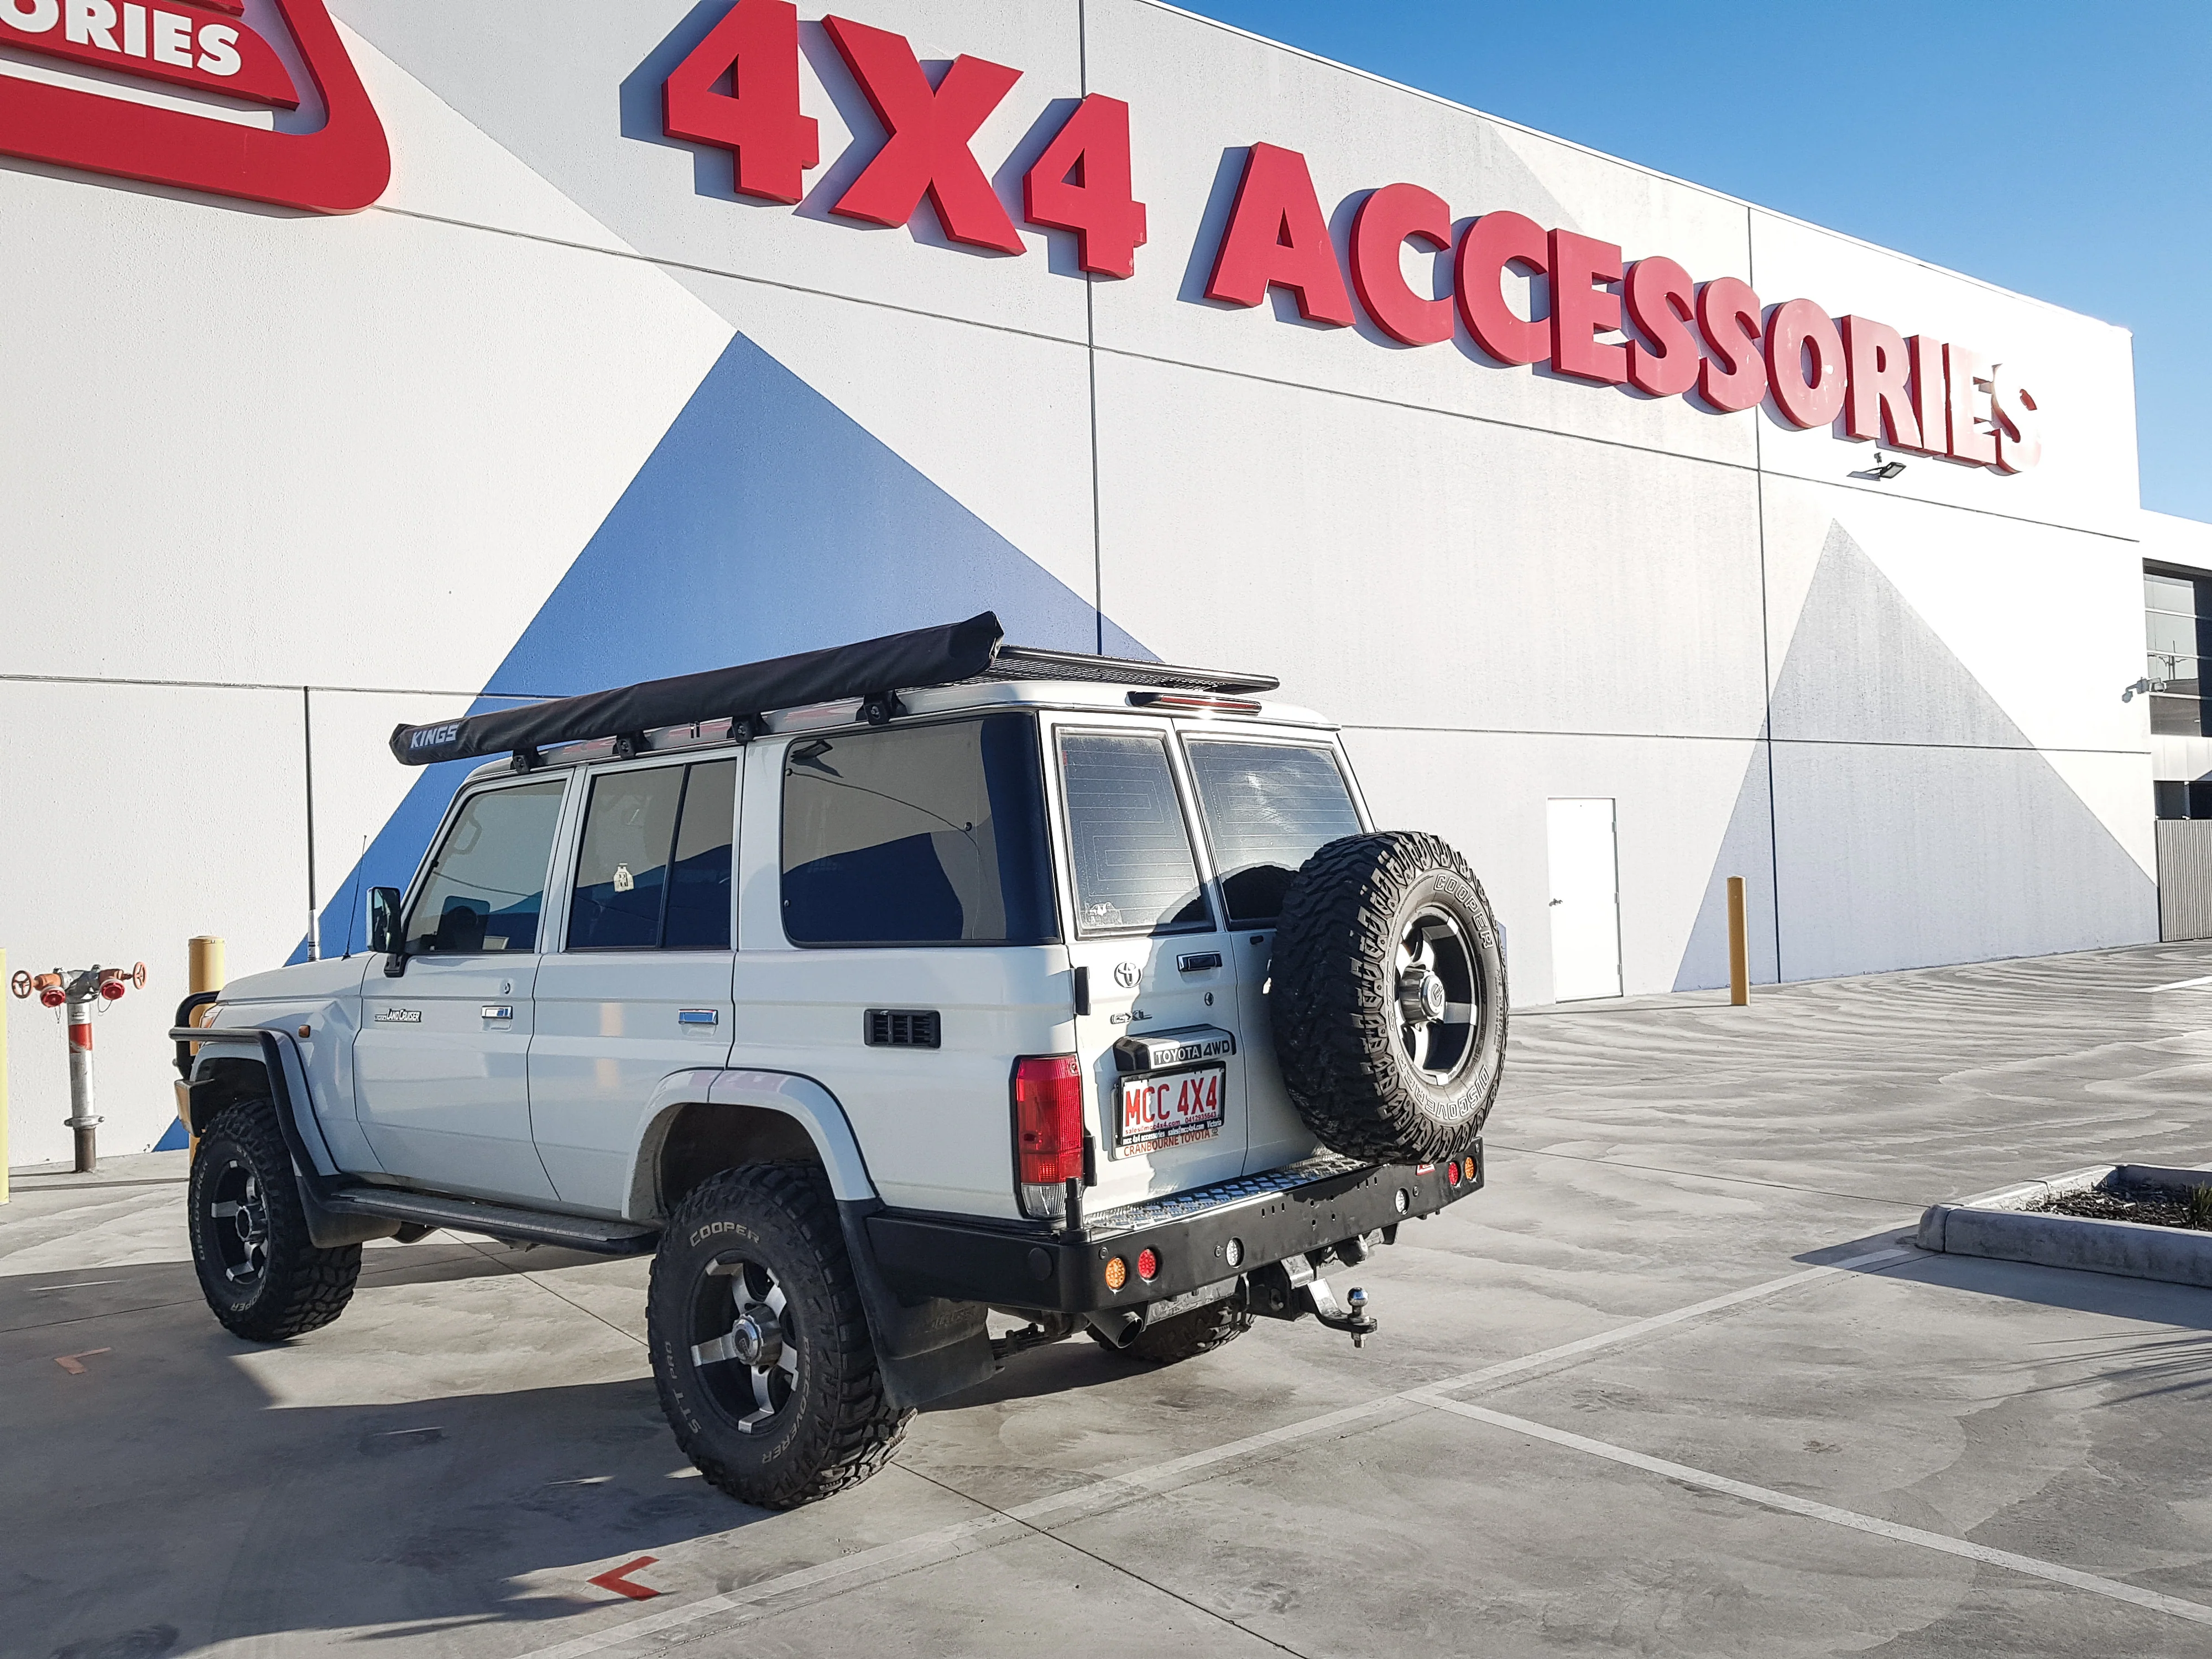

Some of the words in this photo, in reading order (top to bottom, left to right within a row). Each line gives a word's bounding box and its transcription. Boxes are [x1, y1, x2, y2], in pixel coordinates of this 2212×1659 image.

[661, 0, 1147, 280] 4X4
[1203, 141, 2042, 474] ACCESSORIES
[410, 722, 460, 749] KINGS
[1433, 874, 1494, 949] COOPER
[1155, 1046, 1201, 1064] TOYOTA
[1203, 1040, 1230, 1056] 4WD
[1125, 1083, 1170, 1127] MCC
[1177, 1076, 1217, 1116] 4X4
[1397, 1052, 1491, 1120] DISCOVERER
[1124, 1137, 1180, 1157] CRANBOURNE
[1181, 1129, 1211, 1144] TOYOTA
[690, 1221, 760, 1248] COOPER
[665, 1341, 678, 1379] PRO
[672, 1388, 702, 1434] STT
[762, 1335, 811, 1464] DISCOVERER
